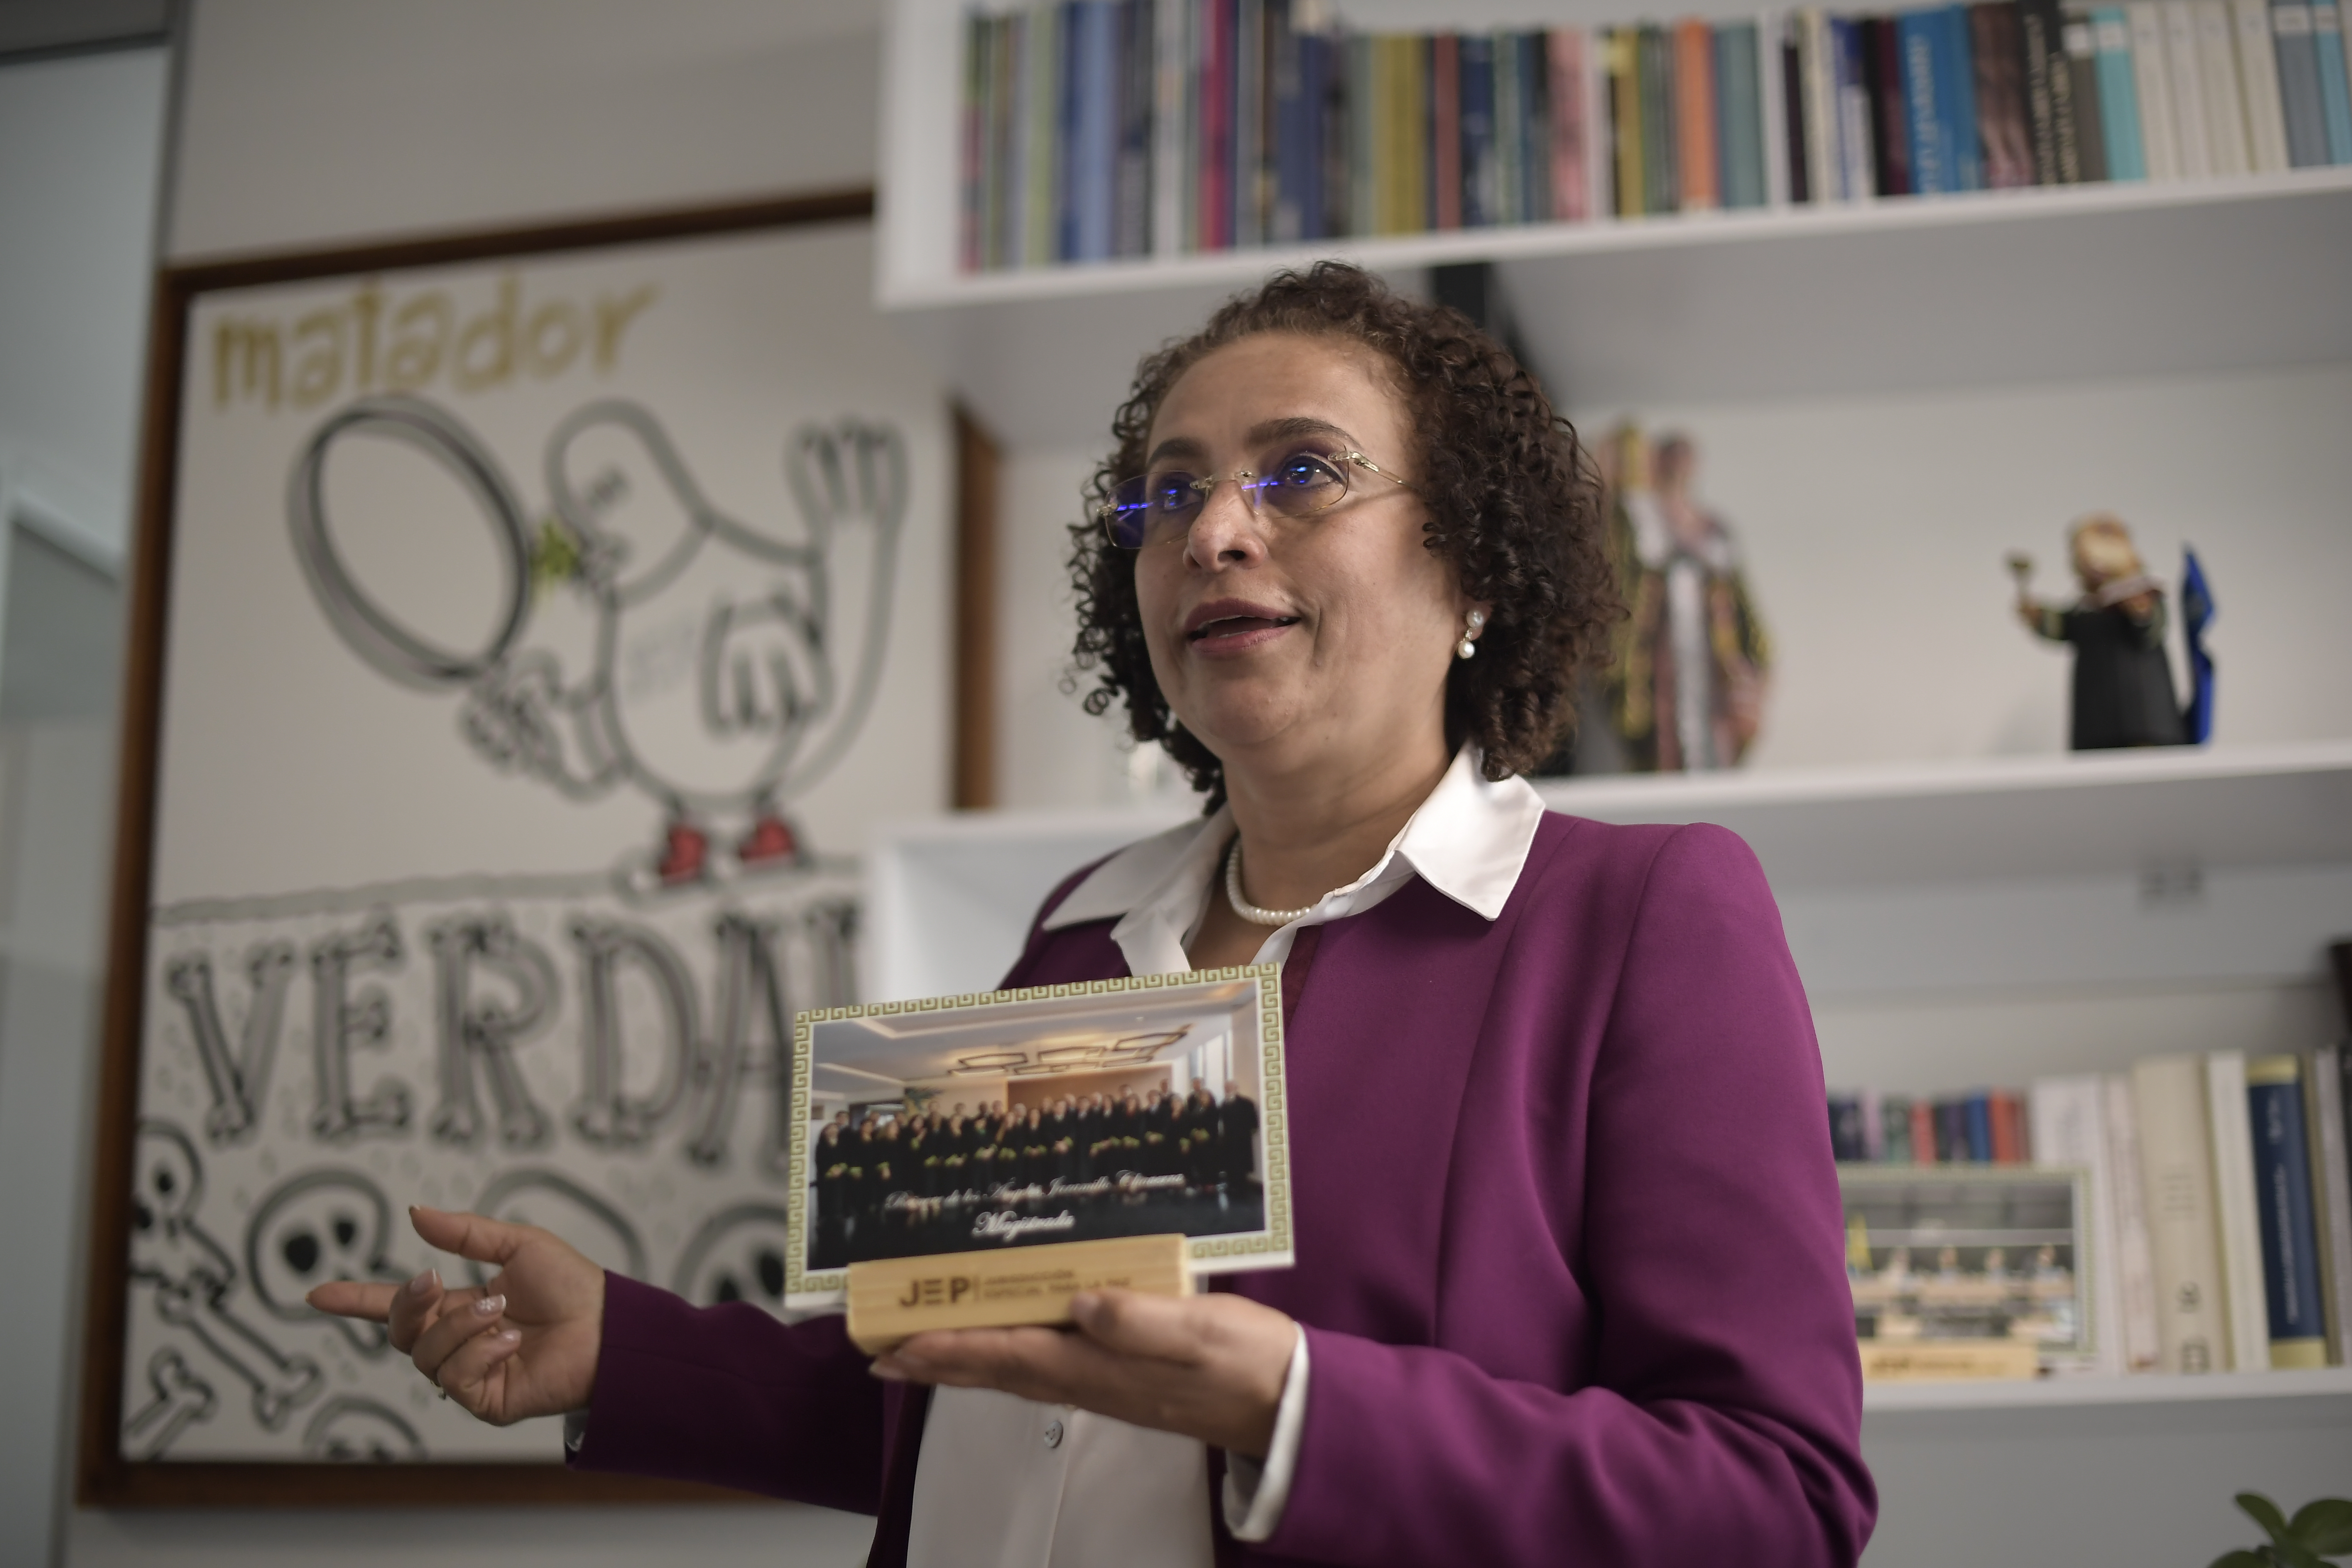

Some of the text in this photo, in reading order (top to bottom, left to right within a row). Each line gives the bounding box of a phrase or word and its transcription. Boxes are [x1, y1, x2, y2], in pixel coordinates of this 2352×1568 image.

[212, 272, 662, 415] matador
[972, 1209, 1075, 1242] Magistrada
[900, 1276, 970, 1307] JEP
